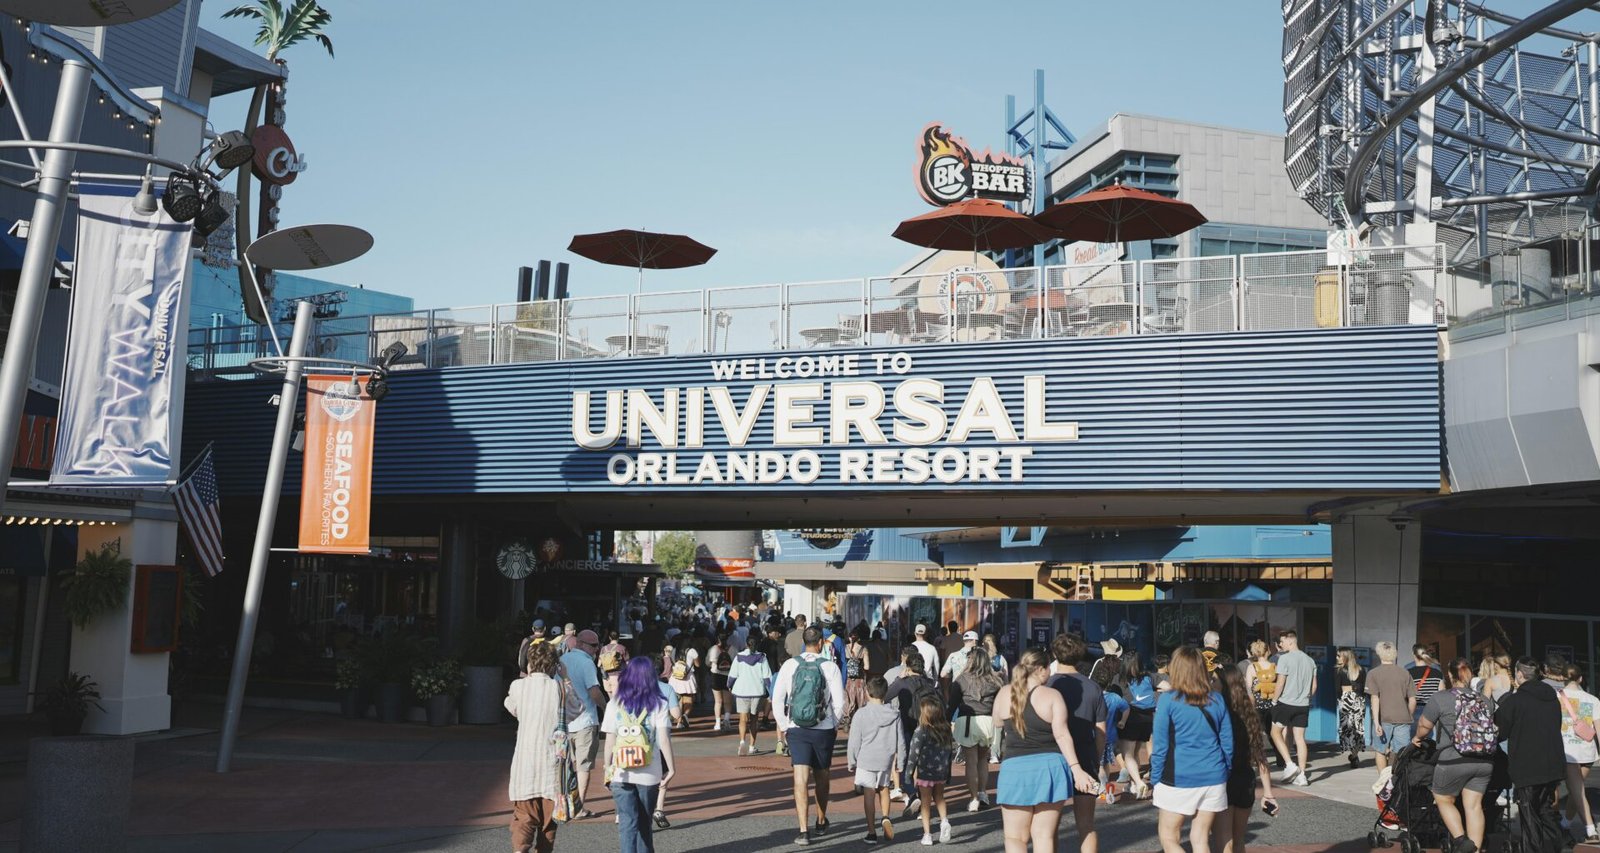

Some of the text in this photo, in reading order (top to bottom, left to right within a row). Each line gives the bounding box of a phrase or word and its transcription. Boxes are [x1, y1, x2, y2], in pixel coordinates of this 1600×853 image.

[266, 146, 308, 178] Club
[933, 162, 965, 189] BK
[970, 162, 1025, 175] WHOPPER
[971, 171, 1025, 193] BAR
[153, 299, 170, 378] UNIVERSAL
[711, 352, 912, 381] WELCOME TO
[572, 375, 1079, 451] UNIVERSAL
[607, 447, 1033, 486] ORLANDO RESORT
[331, 430, 353, 540] SEAFOOD
[321, 493, 332, 546] FAVORITES
[546, 559, 611, 572] ONCIERGE
